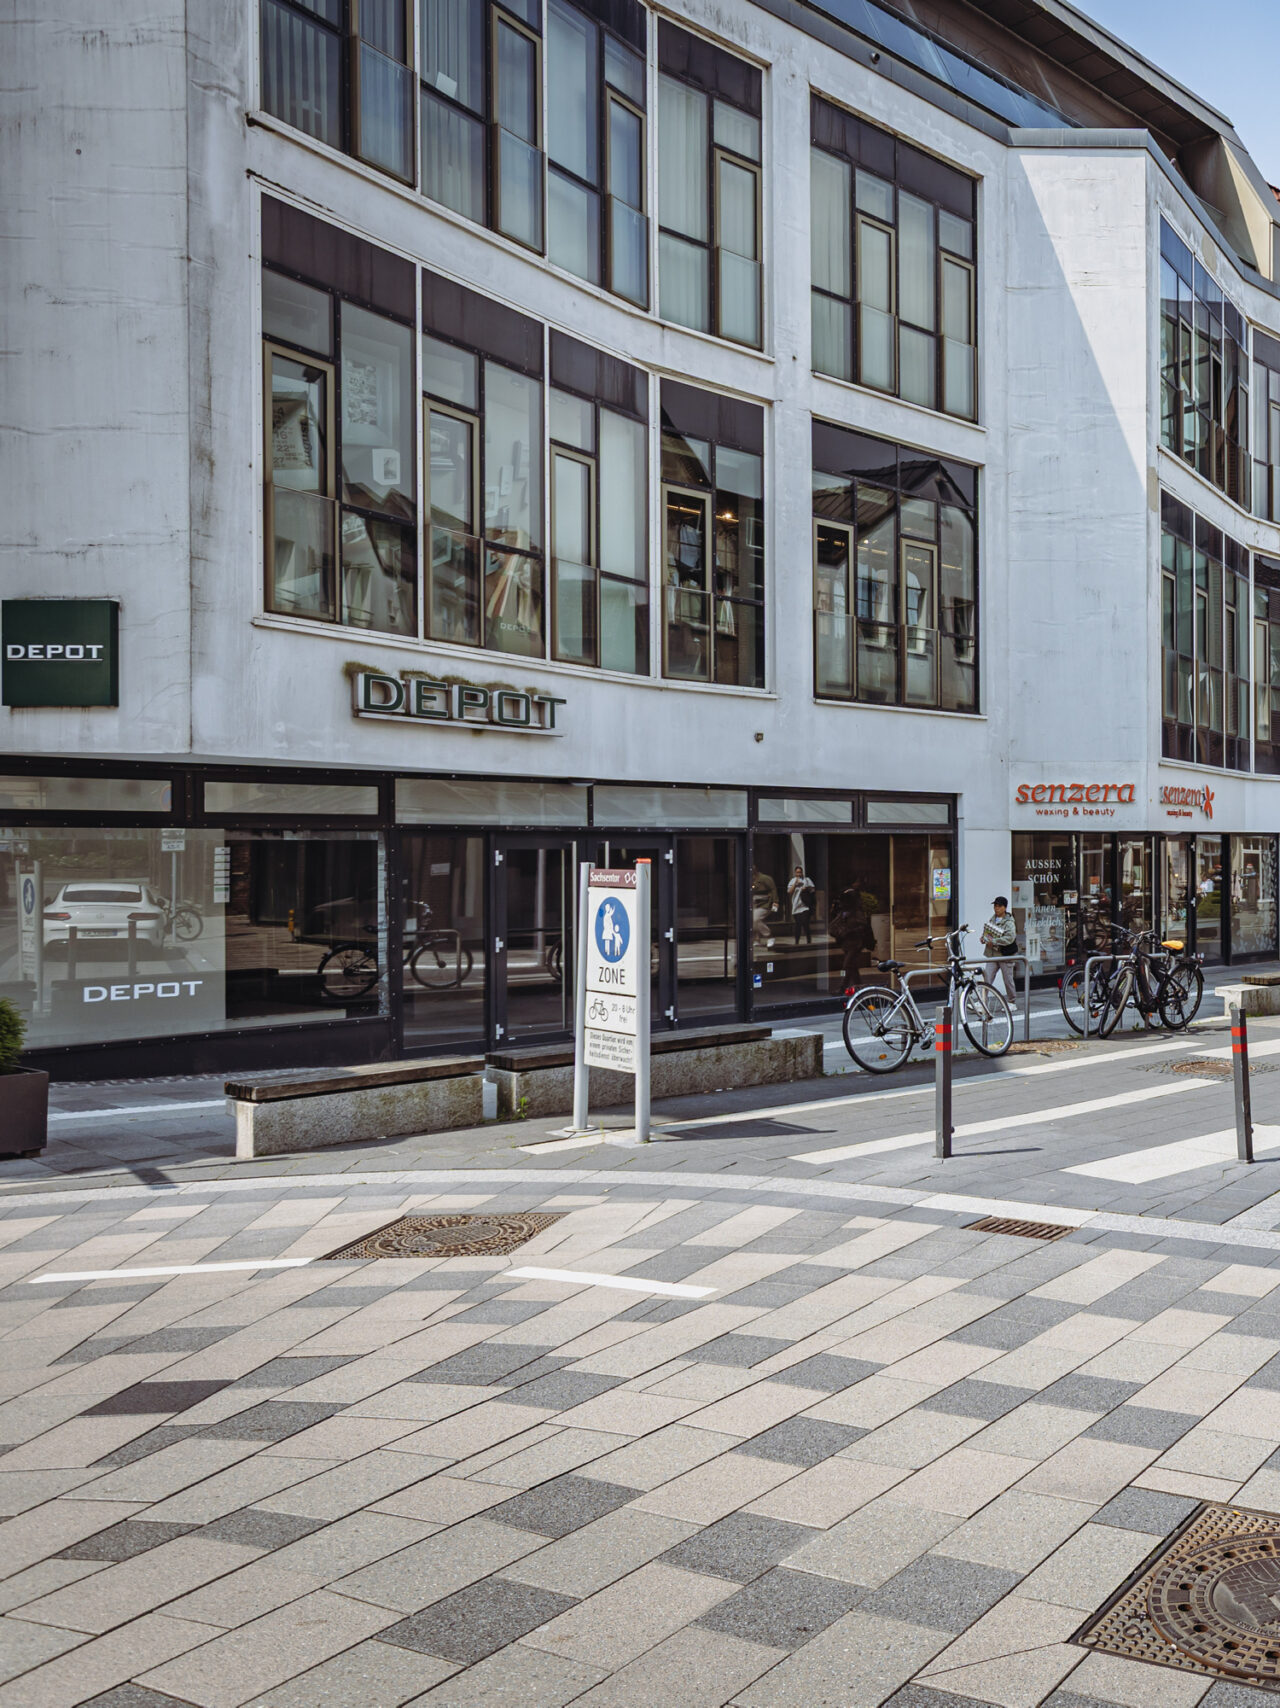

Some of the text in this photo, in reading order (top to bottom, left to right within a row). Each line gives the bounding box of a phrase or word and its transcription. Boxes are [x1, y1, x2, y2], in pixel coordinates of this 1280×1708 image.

[7, 644, 104, 659] DEPOT
[360, 672, 567, 729] DEPOT
[1015, 783, 1136, 803] senzera
[1162, 785, 1202, 807] senzera
[1035, 806, 1116, 818] waxing & beauty
[1025, 859, 1062, 869] AUSSEN
[590, 871, 621, 883] Sachsentor
[1028, 872, 1060, 883] SCHÖN
[598, 966, 626, 985] ZONE
[83, 980, 203, 1003] DEPOT
